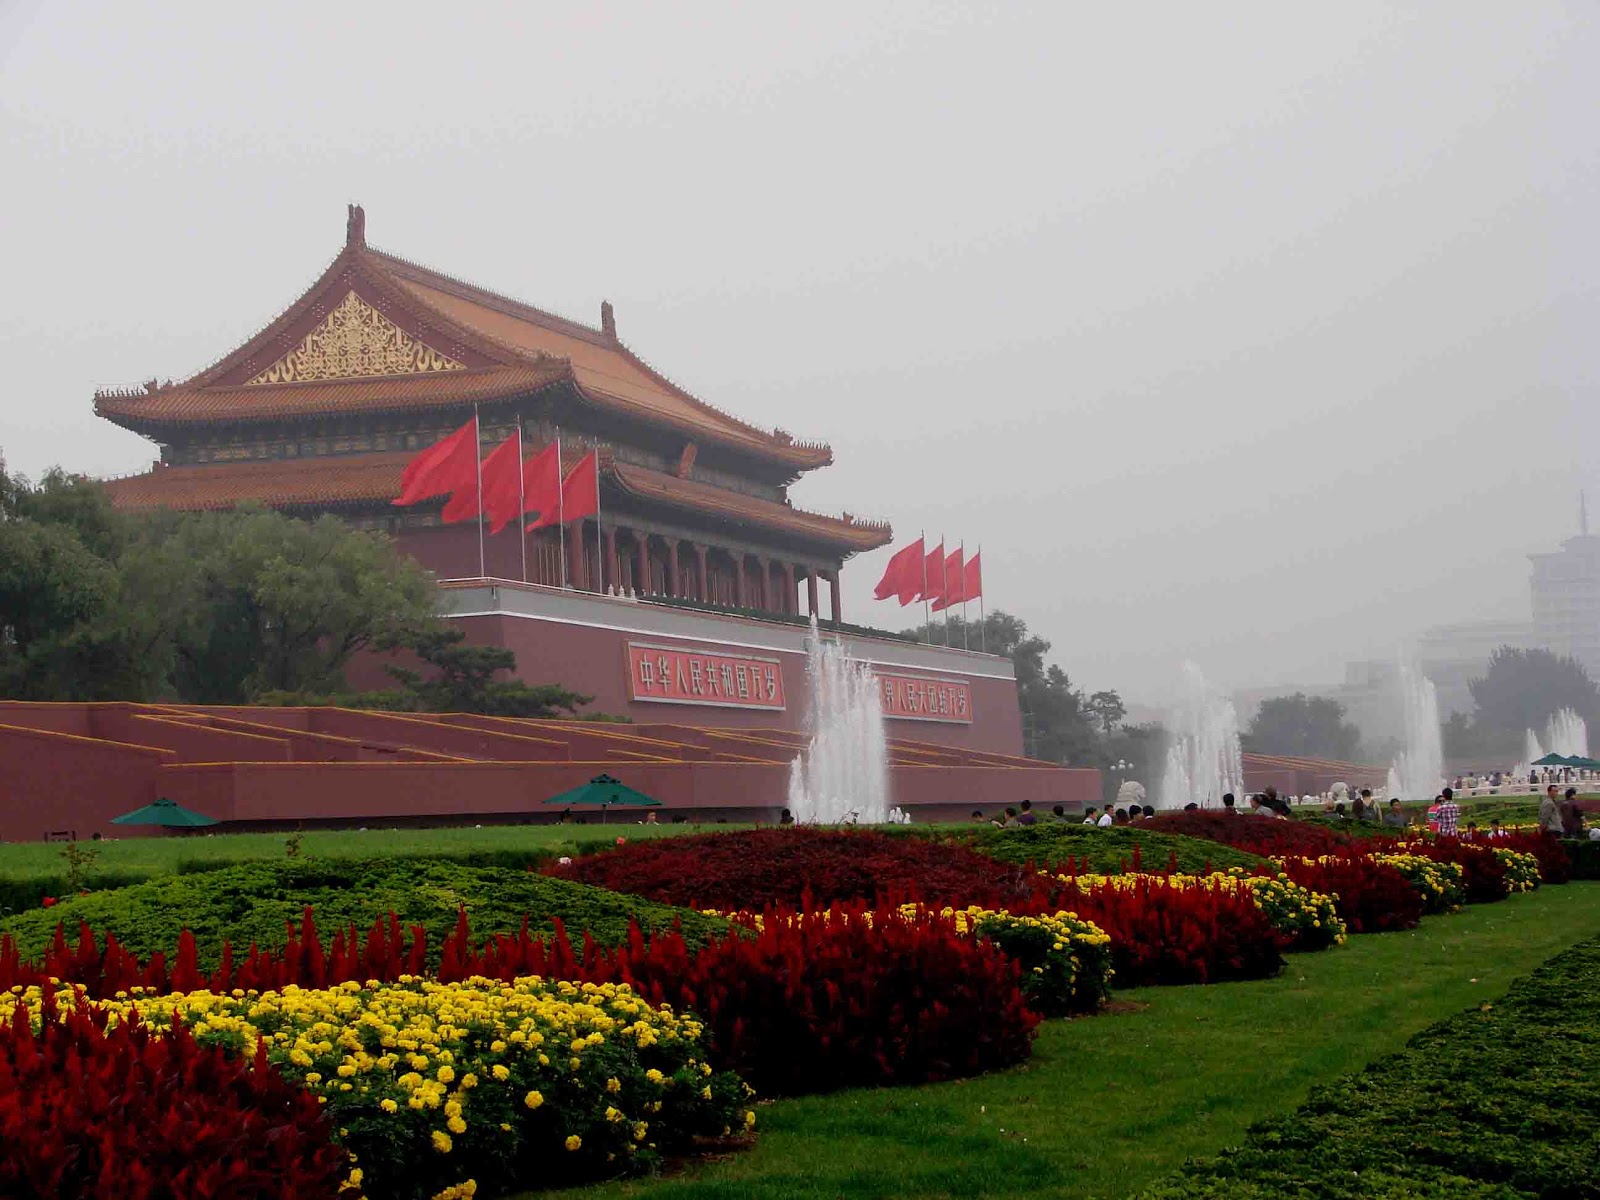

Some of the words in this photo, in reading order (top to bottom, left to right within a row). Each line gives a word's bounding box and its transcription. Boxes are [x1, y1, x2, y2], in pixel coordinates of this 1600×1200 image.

[640, 652, 776, 701] 中华人民共和国万岁
